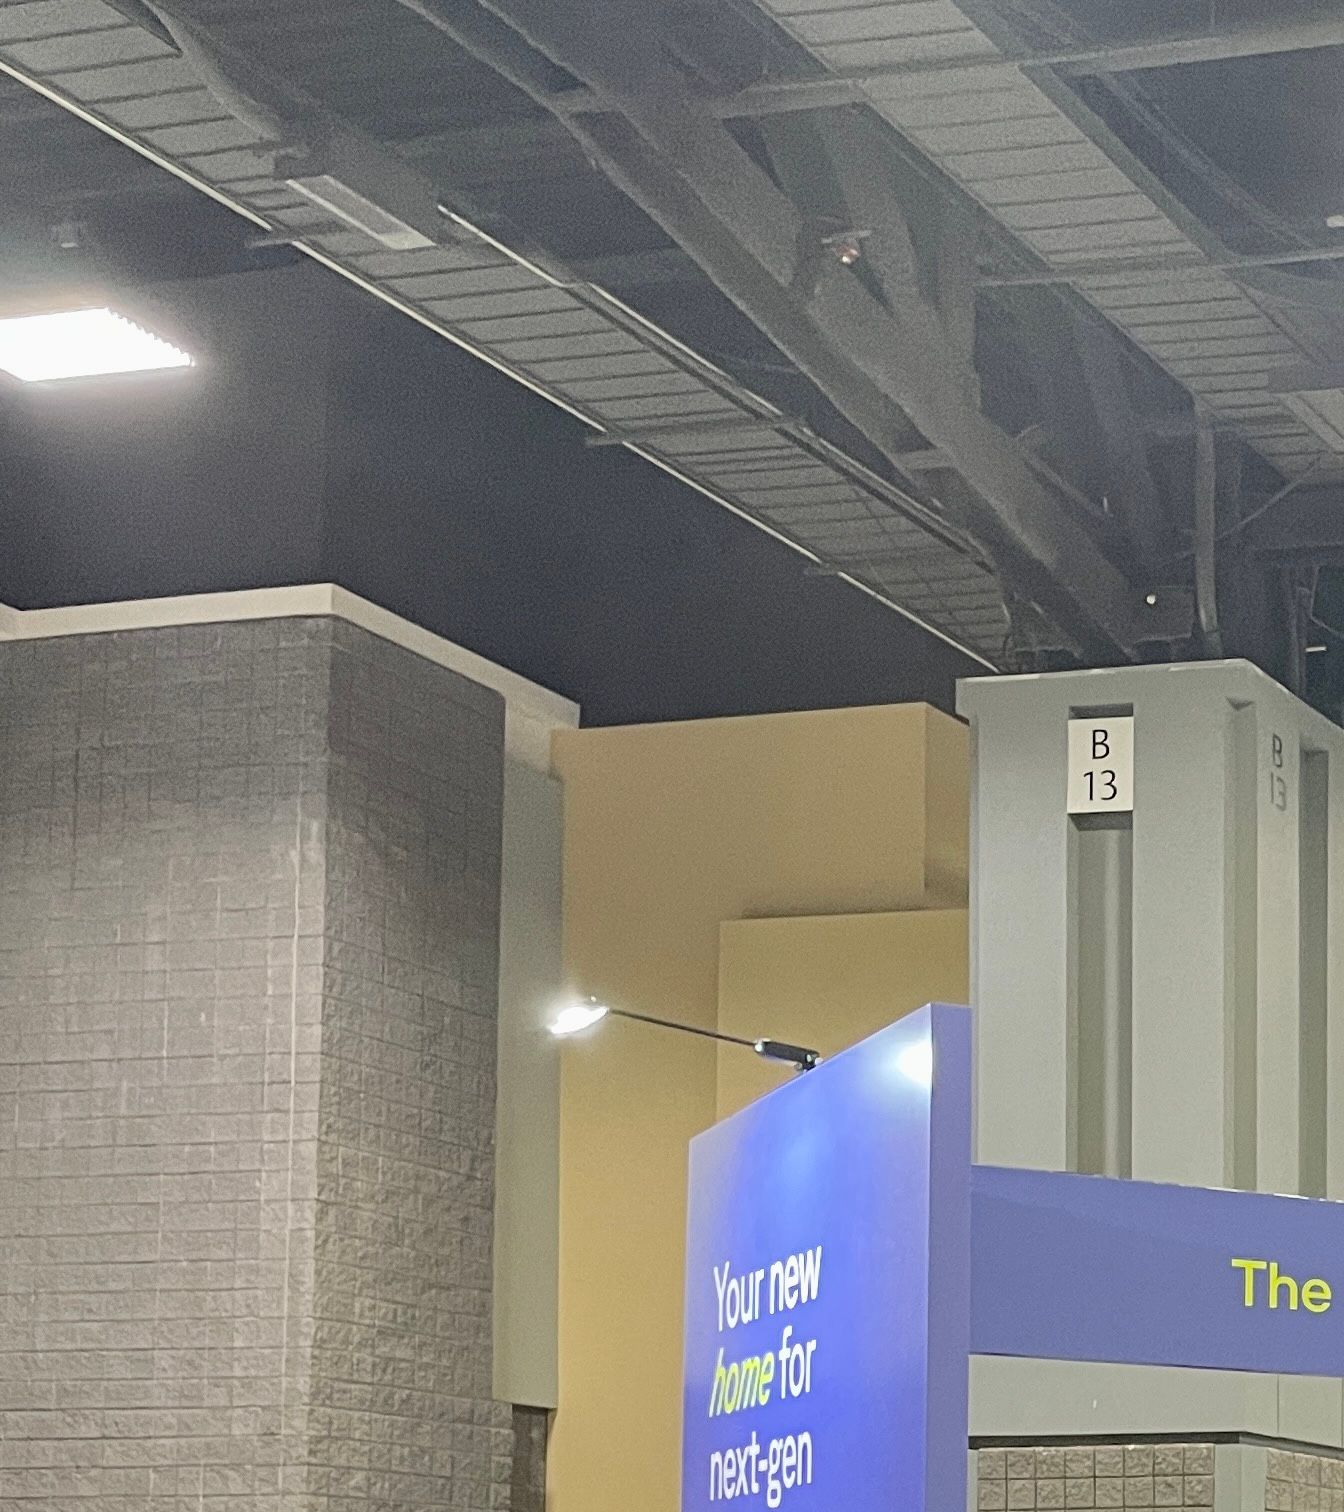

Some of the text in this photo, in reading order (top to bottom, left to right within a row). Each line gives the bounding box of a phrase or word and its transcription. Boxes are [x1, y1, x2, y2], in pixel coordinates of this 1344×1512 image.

[1091, 729, 1110, 760] B
[1082, 769, 1118, 802] 13
[713, 1245, 823, 1332] Your new
[1231, 1258, 1332, 1313] The
[708, 1325, 817, 1418] home for
[710, 1431, 813, 1509] next-gen
